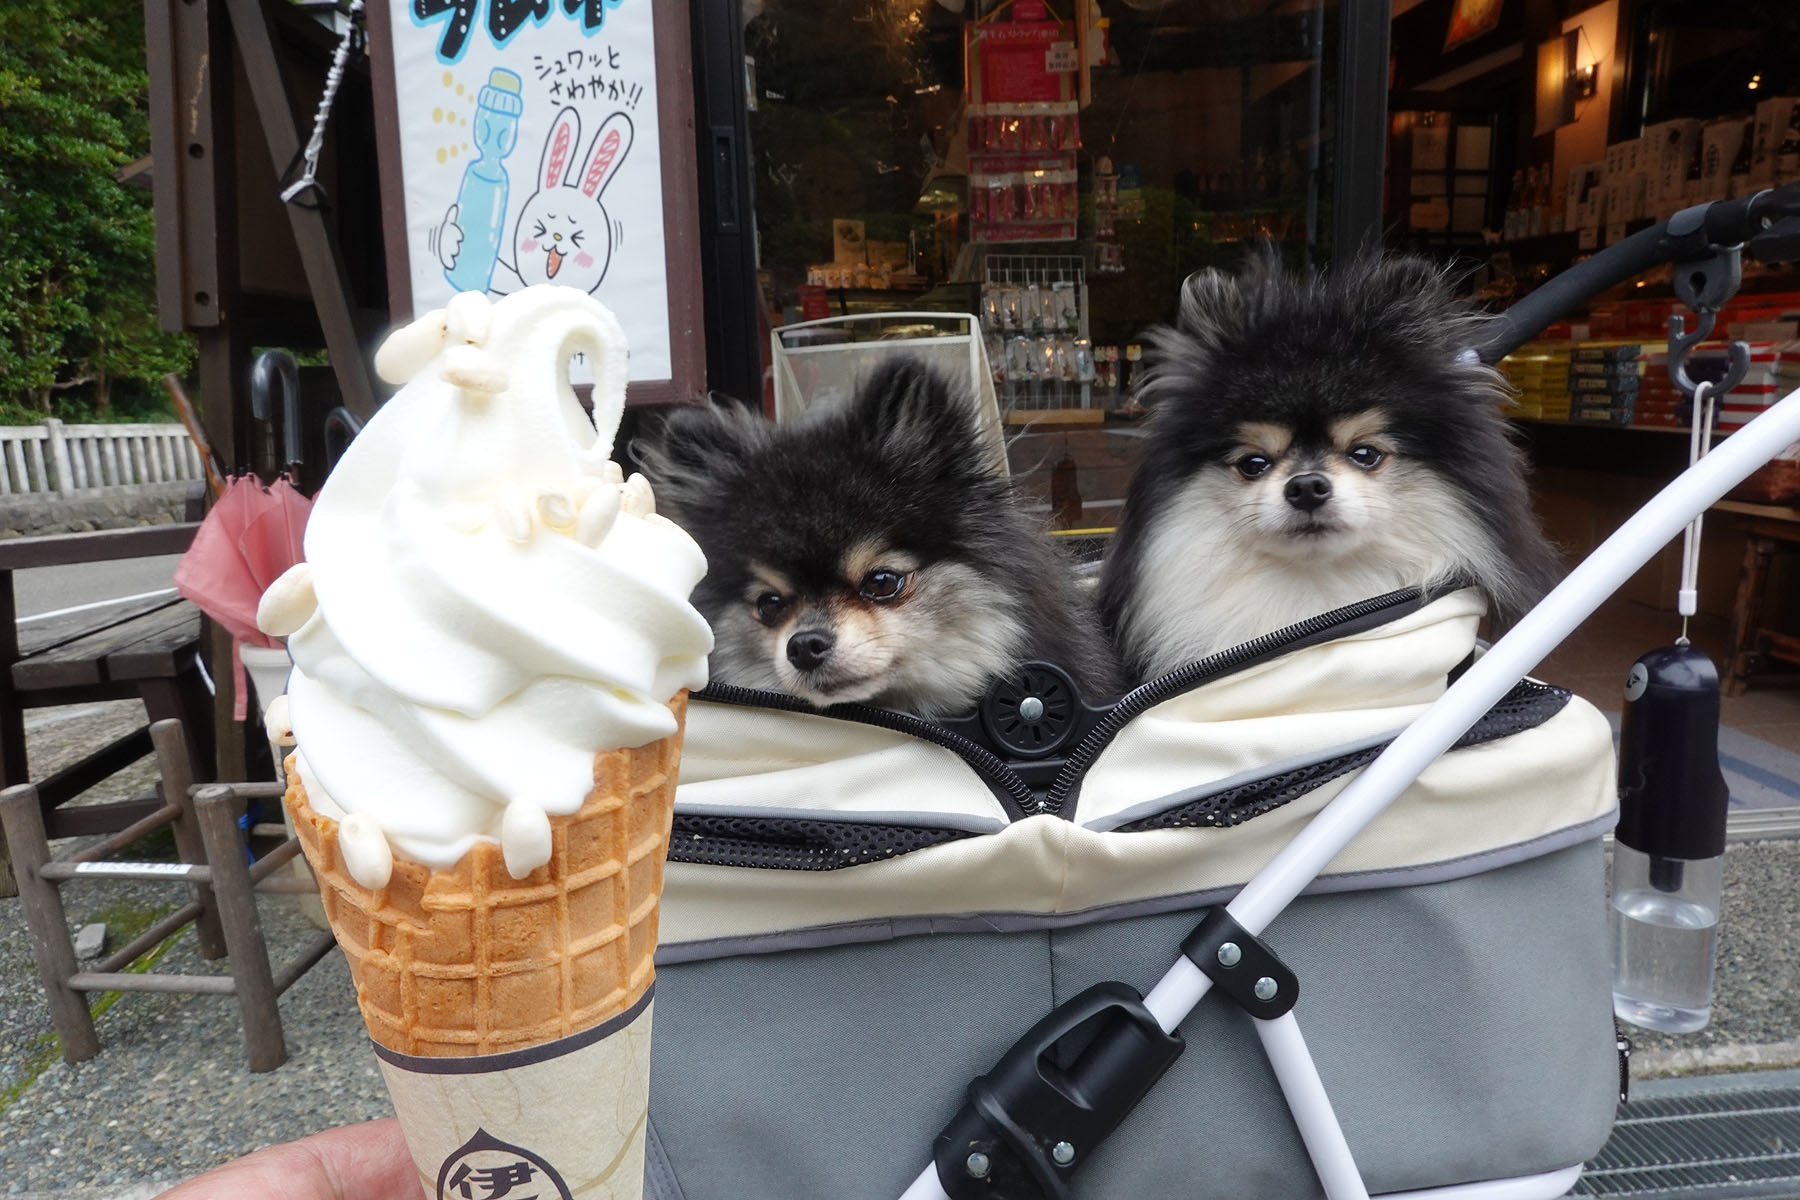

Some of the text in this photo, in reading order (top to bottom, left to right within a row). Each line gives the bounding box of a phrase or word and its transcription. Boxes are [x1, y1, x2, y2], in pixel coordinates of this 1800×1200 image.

[534, 45, 620, 80] シュワッと
[549, 74, 643, 110] さわやか!!
